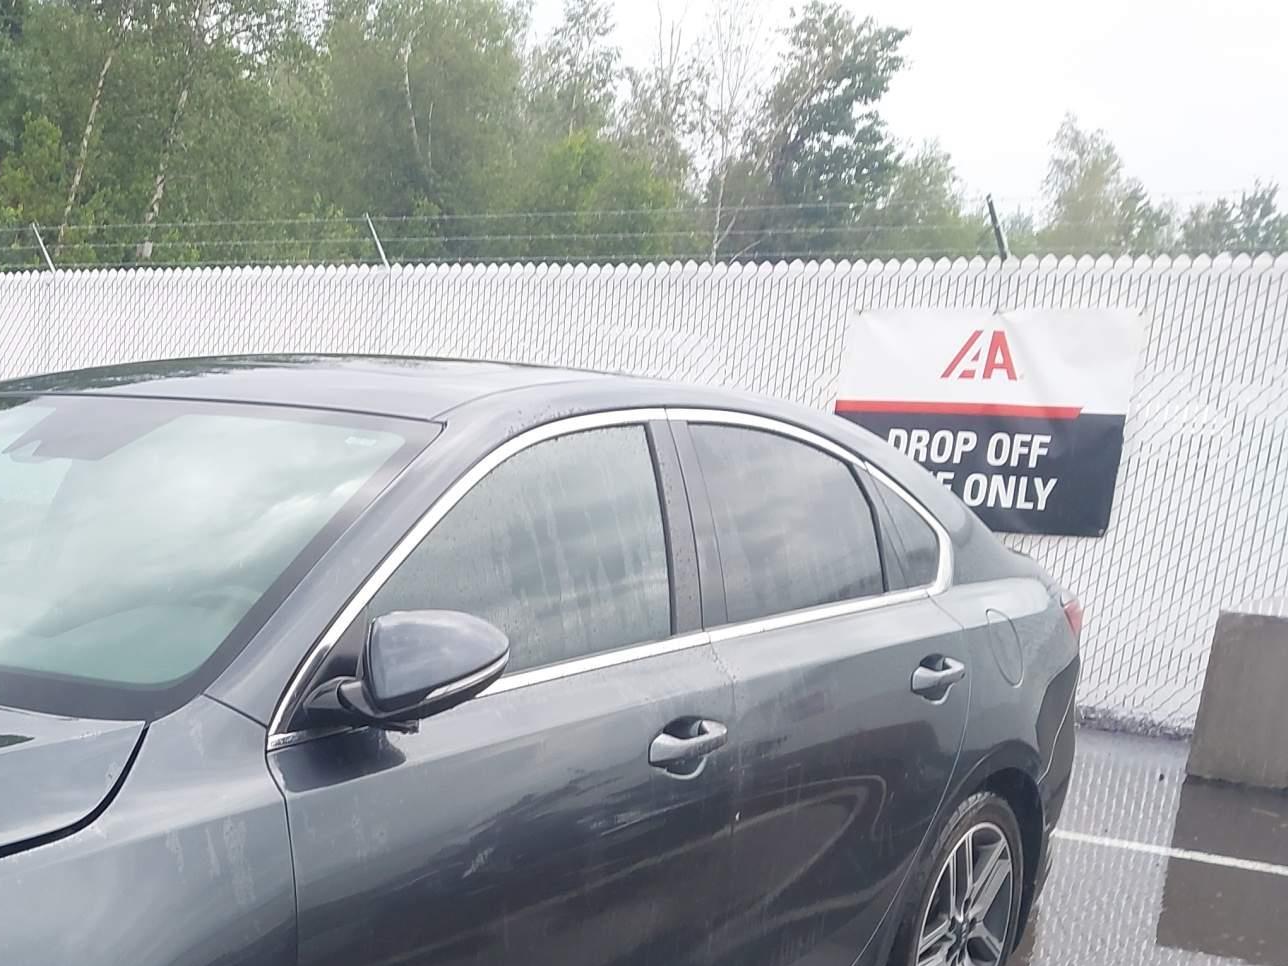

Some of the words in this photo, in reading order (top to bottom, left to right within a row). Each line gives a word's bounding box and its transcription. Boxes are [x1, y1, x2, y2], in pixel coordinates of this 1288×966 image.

[887, 428, 978, 464] DROP
[986, 432, 1052, 469] OFF
[963, 473, 1058, 512] ONLY
